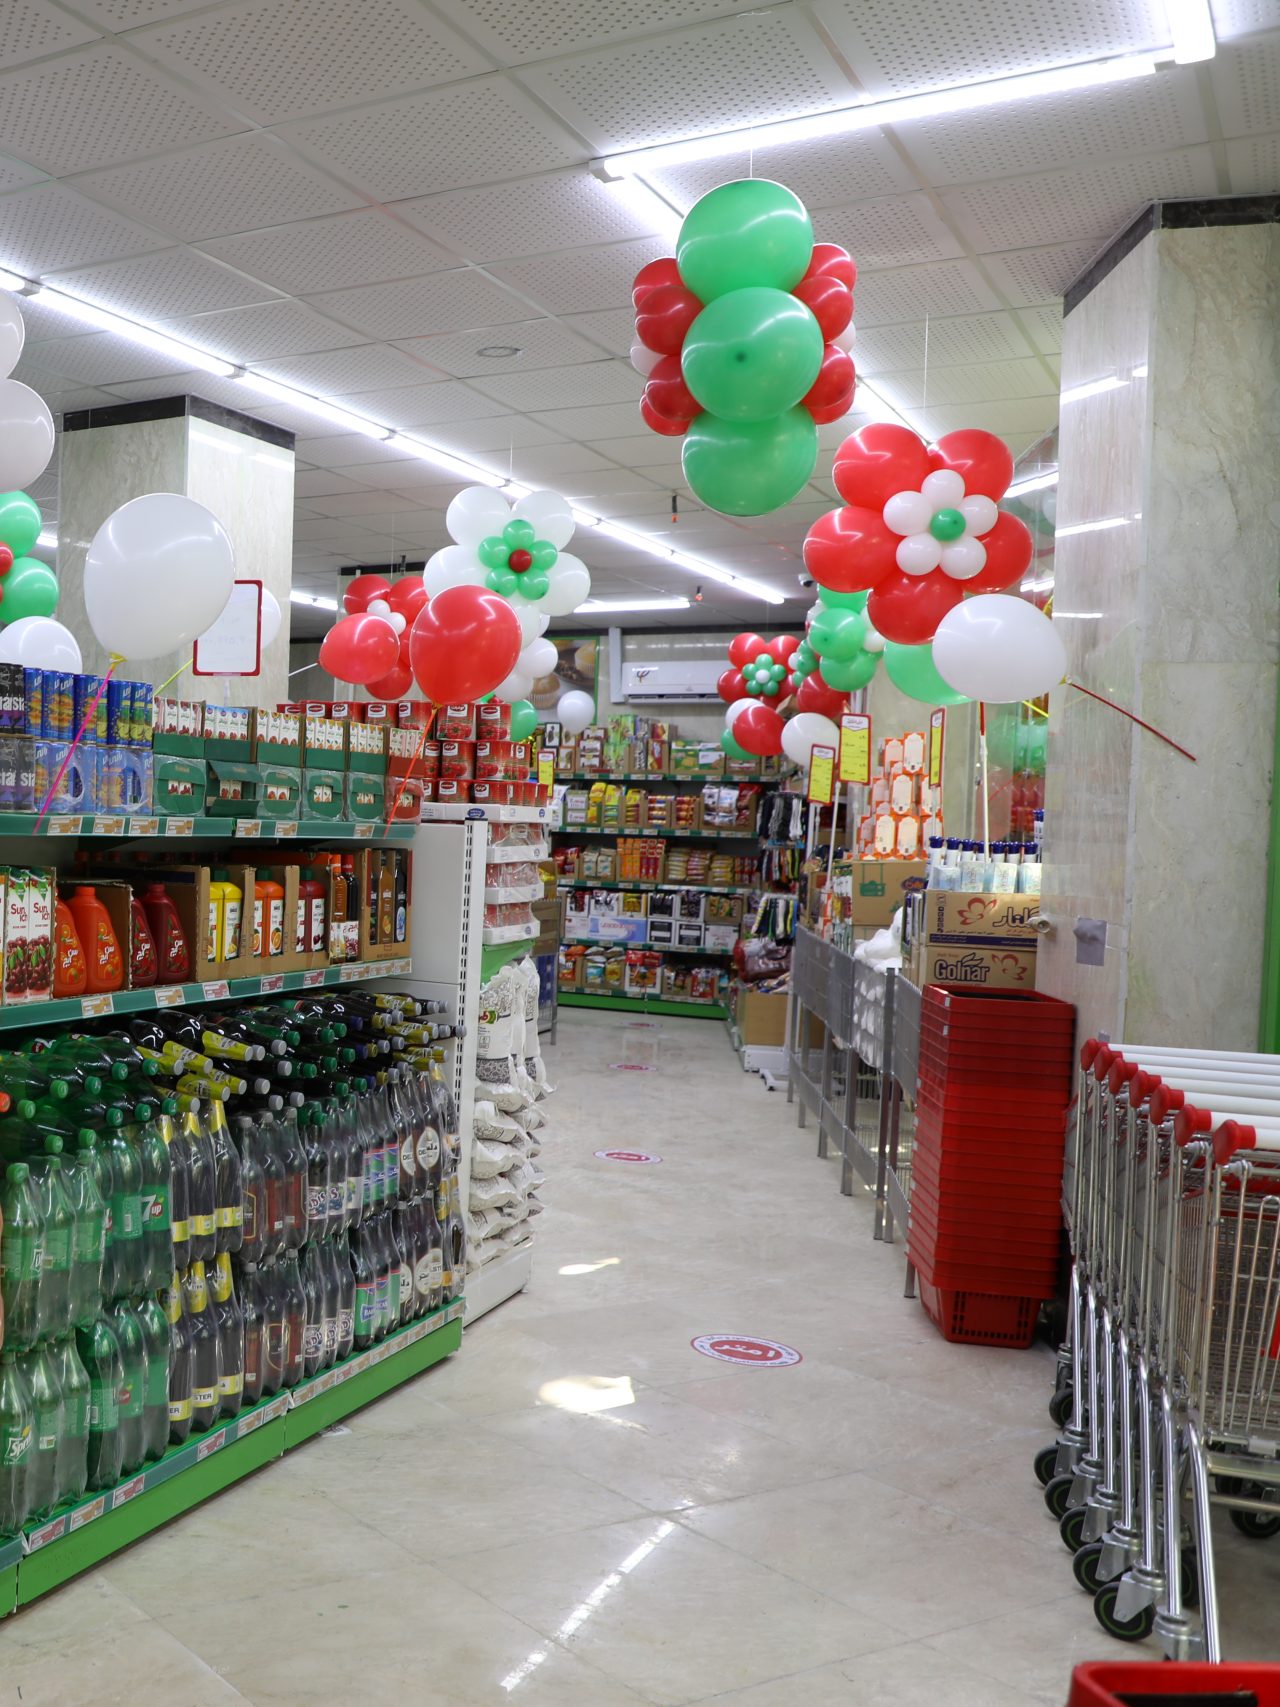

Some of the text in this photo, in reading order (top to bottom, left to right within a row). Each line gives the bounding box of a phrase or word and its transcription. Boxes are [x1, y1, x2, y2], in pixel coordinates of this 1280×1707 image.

[11, 903, 25, 915] Sun
[33, 902, 47, 913] Sun
[934, 959, 990, 982] Golnar
[141, 1194, 163, 1223] 7up
